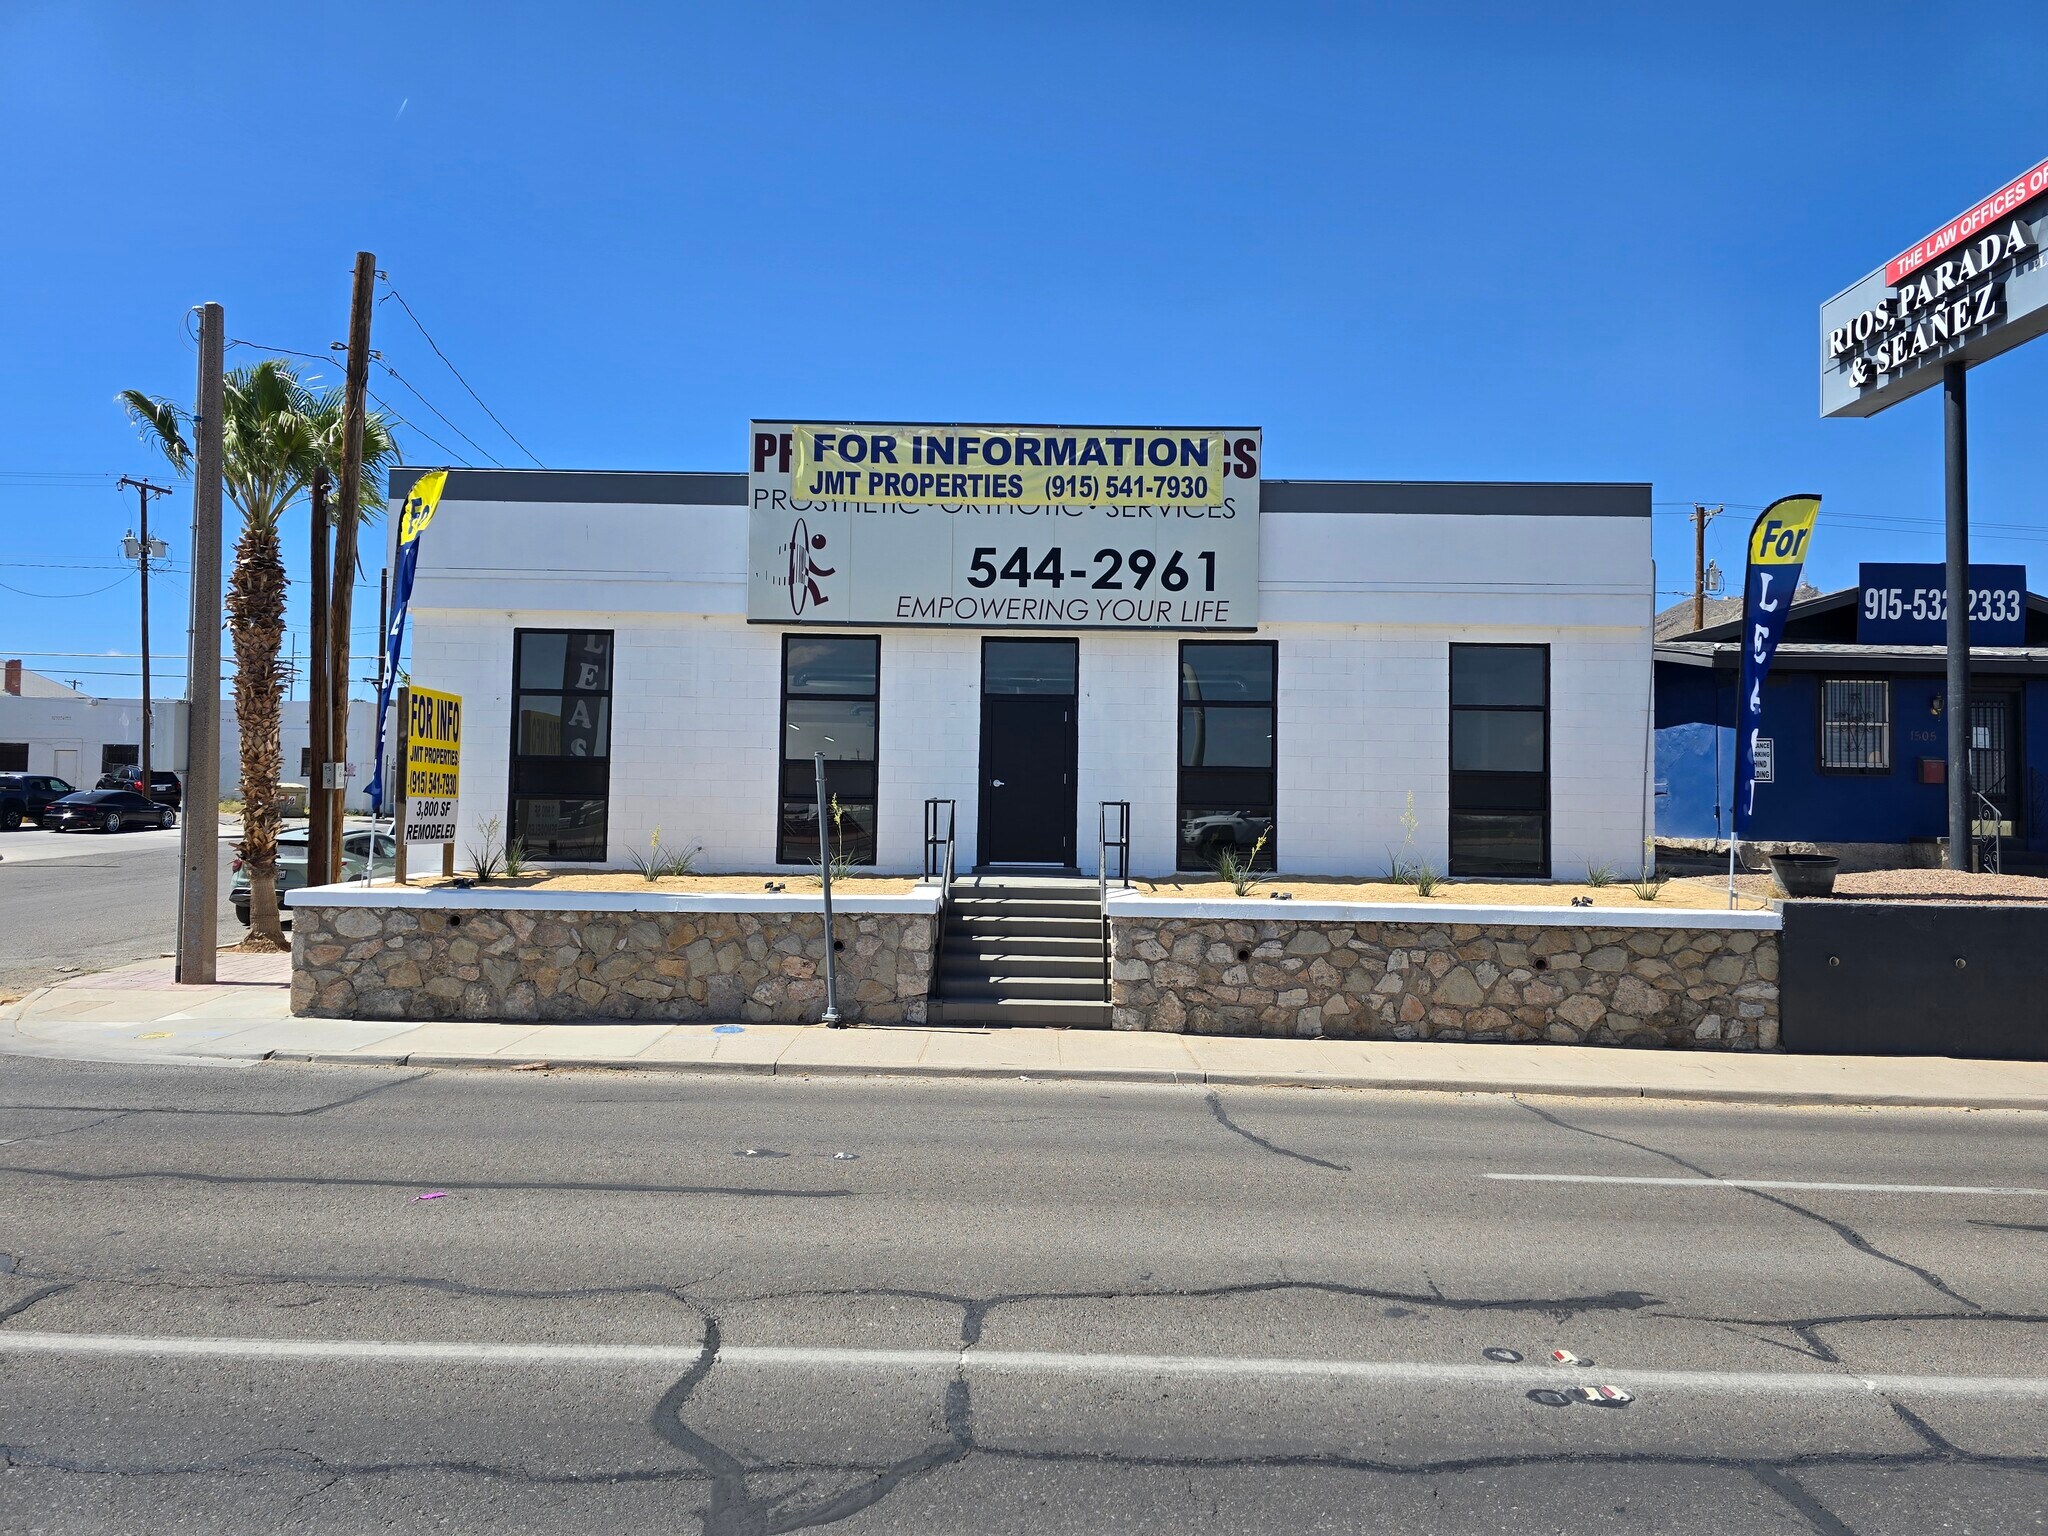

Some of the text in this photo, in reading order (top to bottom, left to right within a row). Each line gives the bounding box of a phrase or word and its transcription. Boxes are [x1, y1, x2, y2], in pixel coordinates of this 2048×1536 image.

[1897, 249, 1923, 274] THE
[1926, 226, 1957, 256] LAW
[1960, 182, 2026, 235] OFFICES
[1828, 220, 2027, 359] RIOS, PARADA
[1849, 282, 1996, 388] & SEAÑEZ
[814, 434, 898, 463] FOR
[912, 436, 1209, 467] INFORMATION
[809, 471, 1208, 501] JMT PROPERTIES (915) 541-7930
[1760, 520, 1809, 557] For
[967, 546, 1216, 592] 544-2961
[896, 596, 1230, 623] EMPOWERING YOUR LIFE
[410, 693, 460, 744] FOR INFO
[1910, 730, 1937, 742] 1505
[410, 745, 458, 767] JMT PROPERTIES
[410, 769, 457, 796] (915) 541-7930
[416, 800, 452, 820] 3,800 SF
[405, 823, 456, 841] REMODELED
